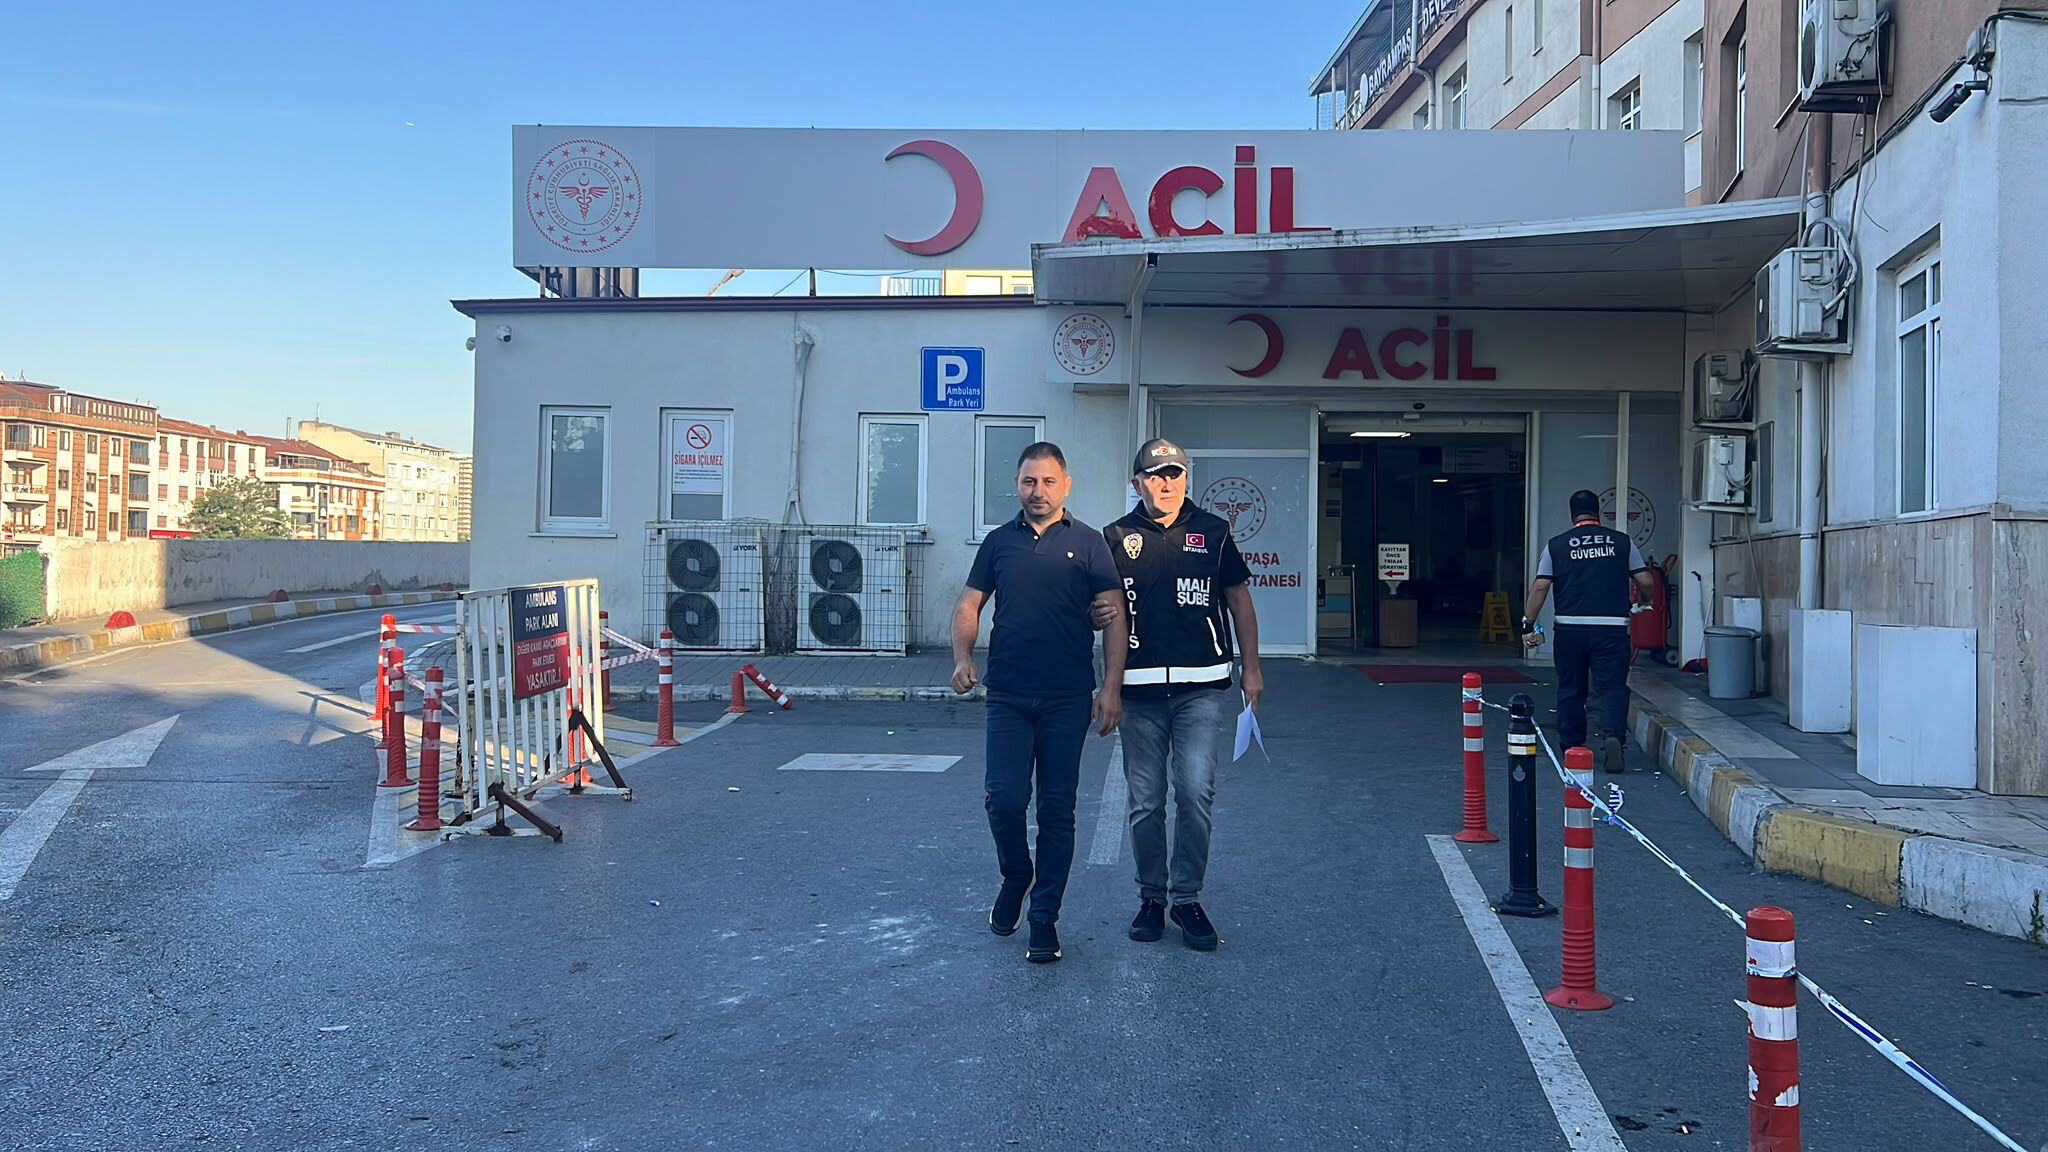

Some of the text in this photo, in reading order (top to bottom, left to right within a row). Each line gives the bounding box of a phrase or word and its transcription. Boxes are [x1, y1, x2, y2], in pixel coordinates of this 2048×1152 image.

[1061, 145, 1332, 243] ACİL
[1322, 315, 1496, 380] ACİL
[937, 355, 968, 401] P
[947, 387, 980, 395] Ambulans
[948, 398, 979, 407] Park Yeri
[675, 451, 723, 468] SİGARA İÇİLMEZ
[1182, 545, 1208, 553] İSTANBUL
[1569, 535, 1615, 547] ÖZEL
[1570, 545, 1615, 559] GÜVENLİK
[1176, 577, 1211, 593] MALİ
[1176, 591, 1210, 607] ŞUBE
[1123, 577, 1140, 649] POLİS
[525, 612, 559, 632] PARK ALANI
